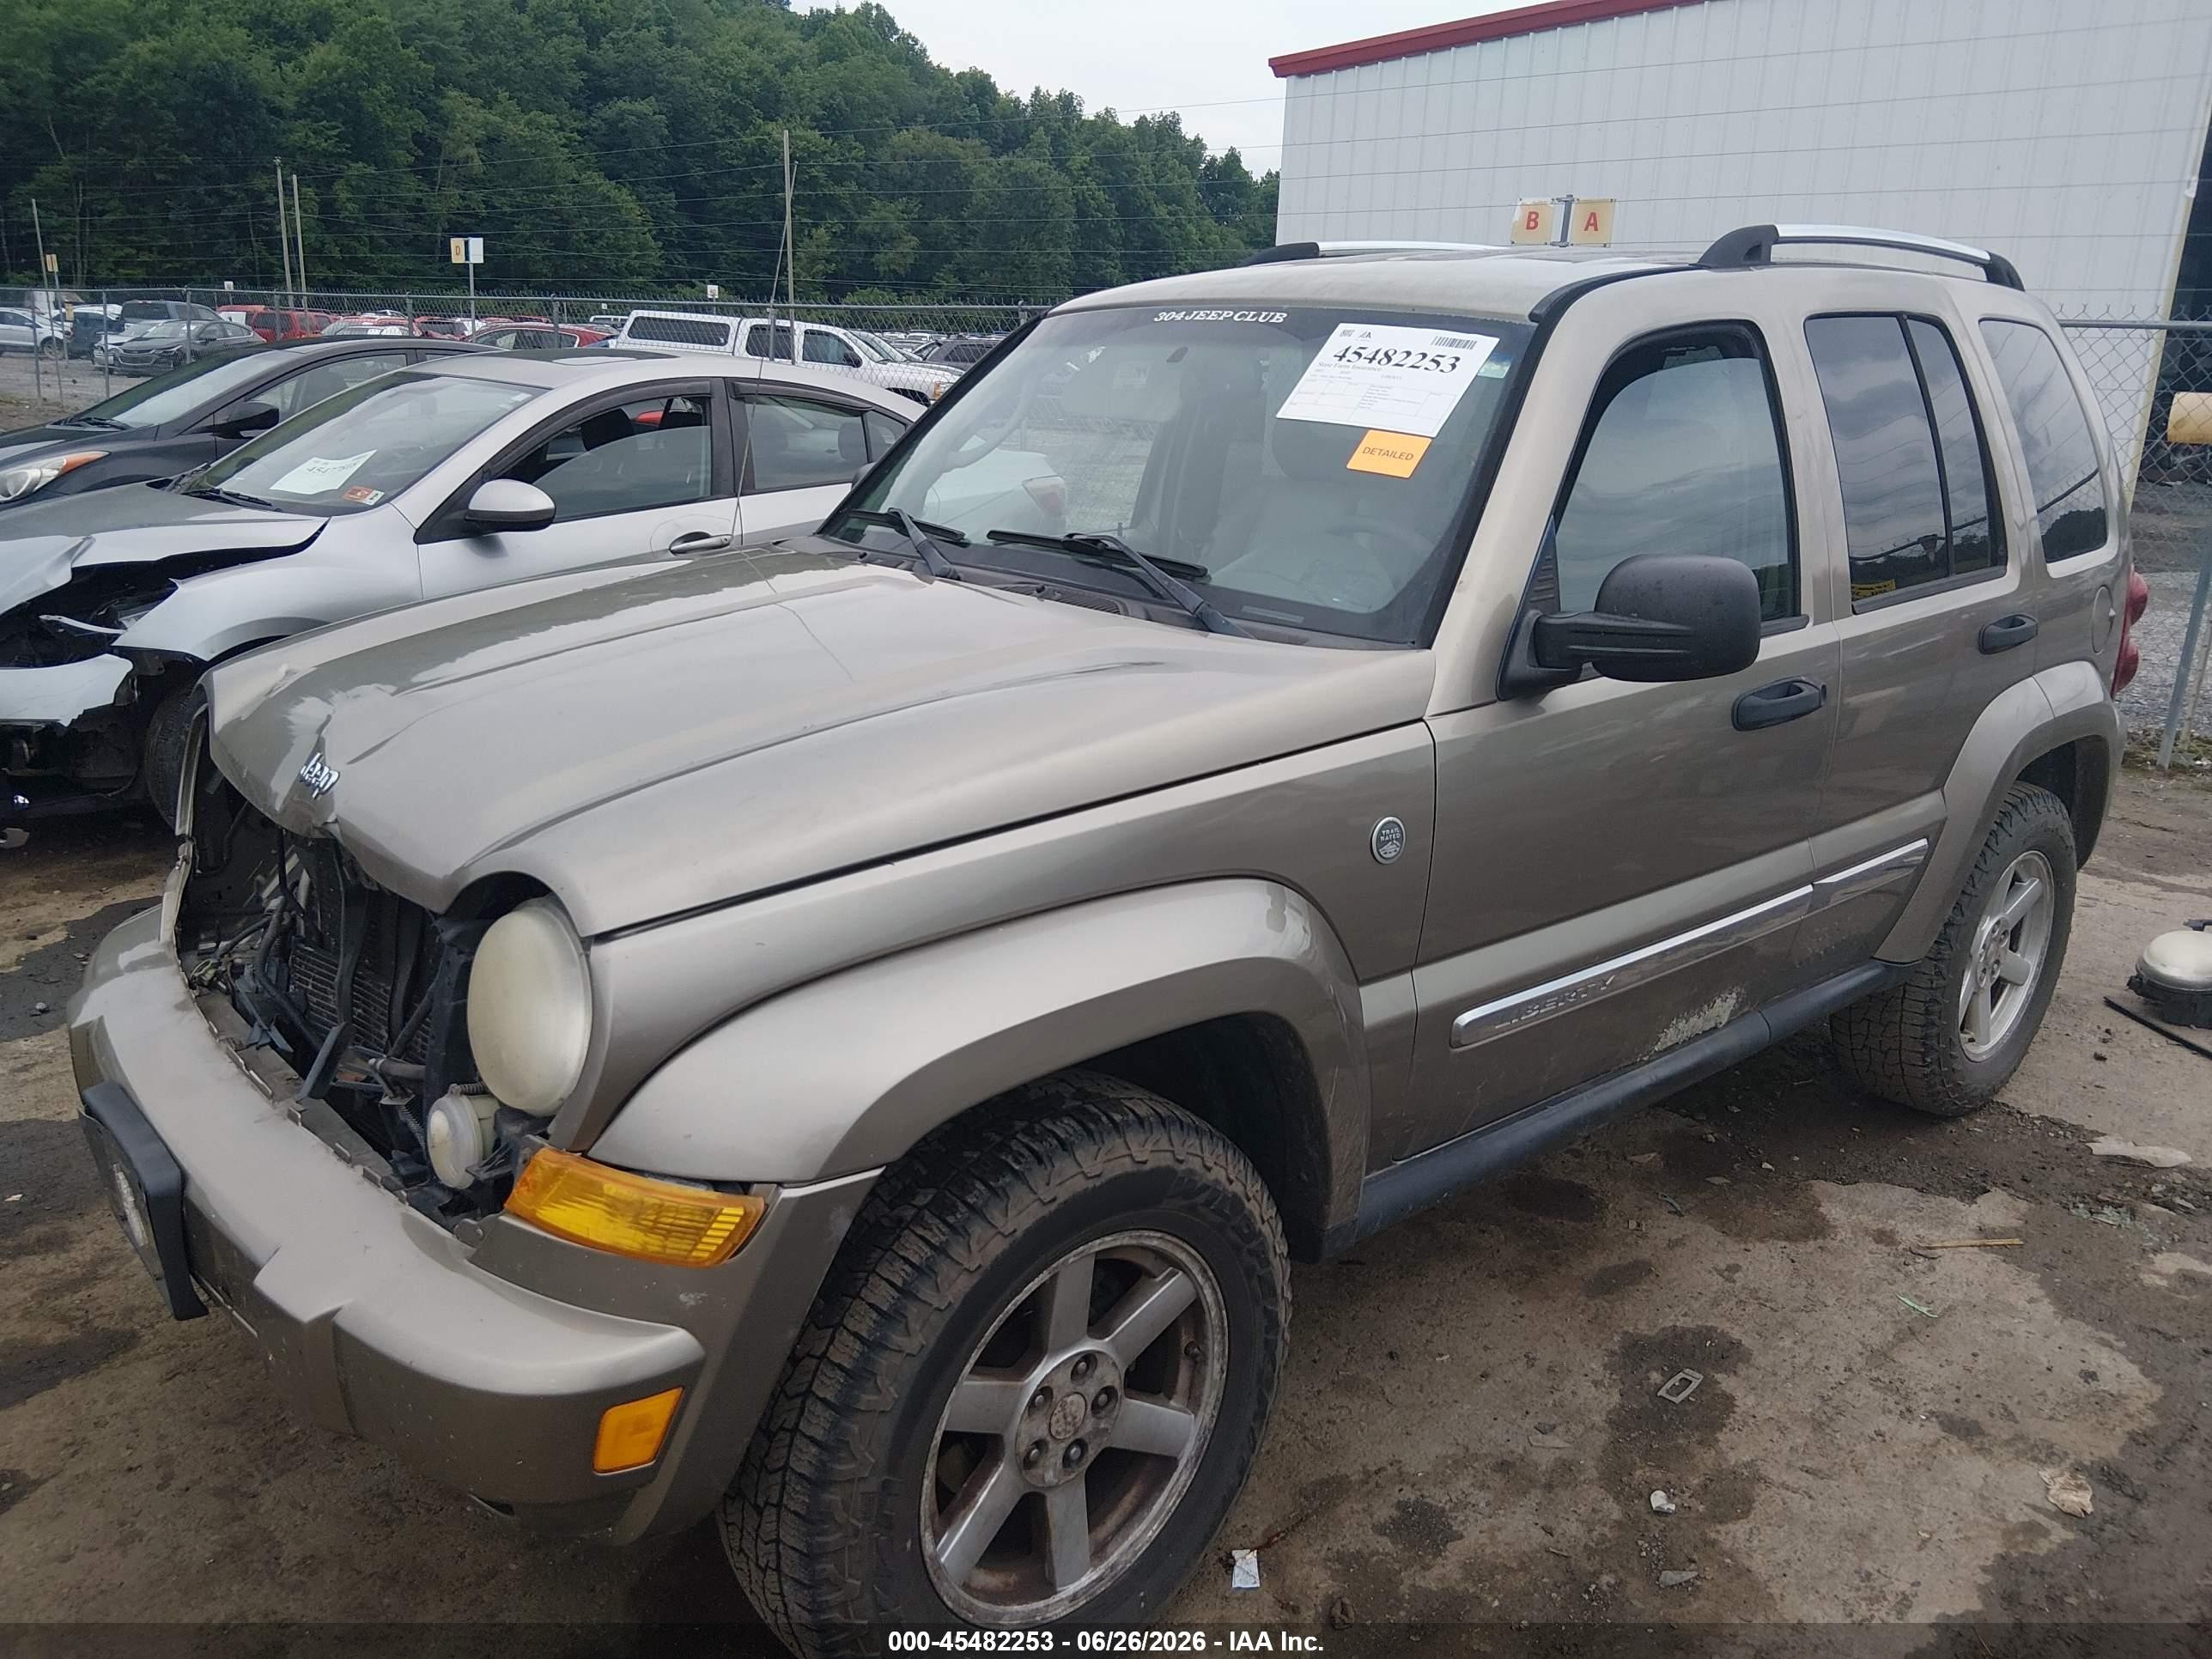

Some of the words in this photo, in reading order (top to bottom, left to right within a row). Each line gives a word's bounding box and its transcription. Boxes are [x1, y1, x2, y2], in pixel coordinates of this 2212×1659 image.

[1525, 211, 1540, 230] B
[1583, 211, 1599, 231] A
[1232, 311, 1288, 323] CLUB
[1333, 345, 1461, 373] 45482253
[1362, 447, 1414, 461] DETAILED
